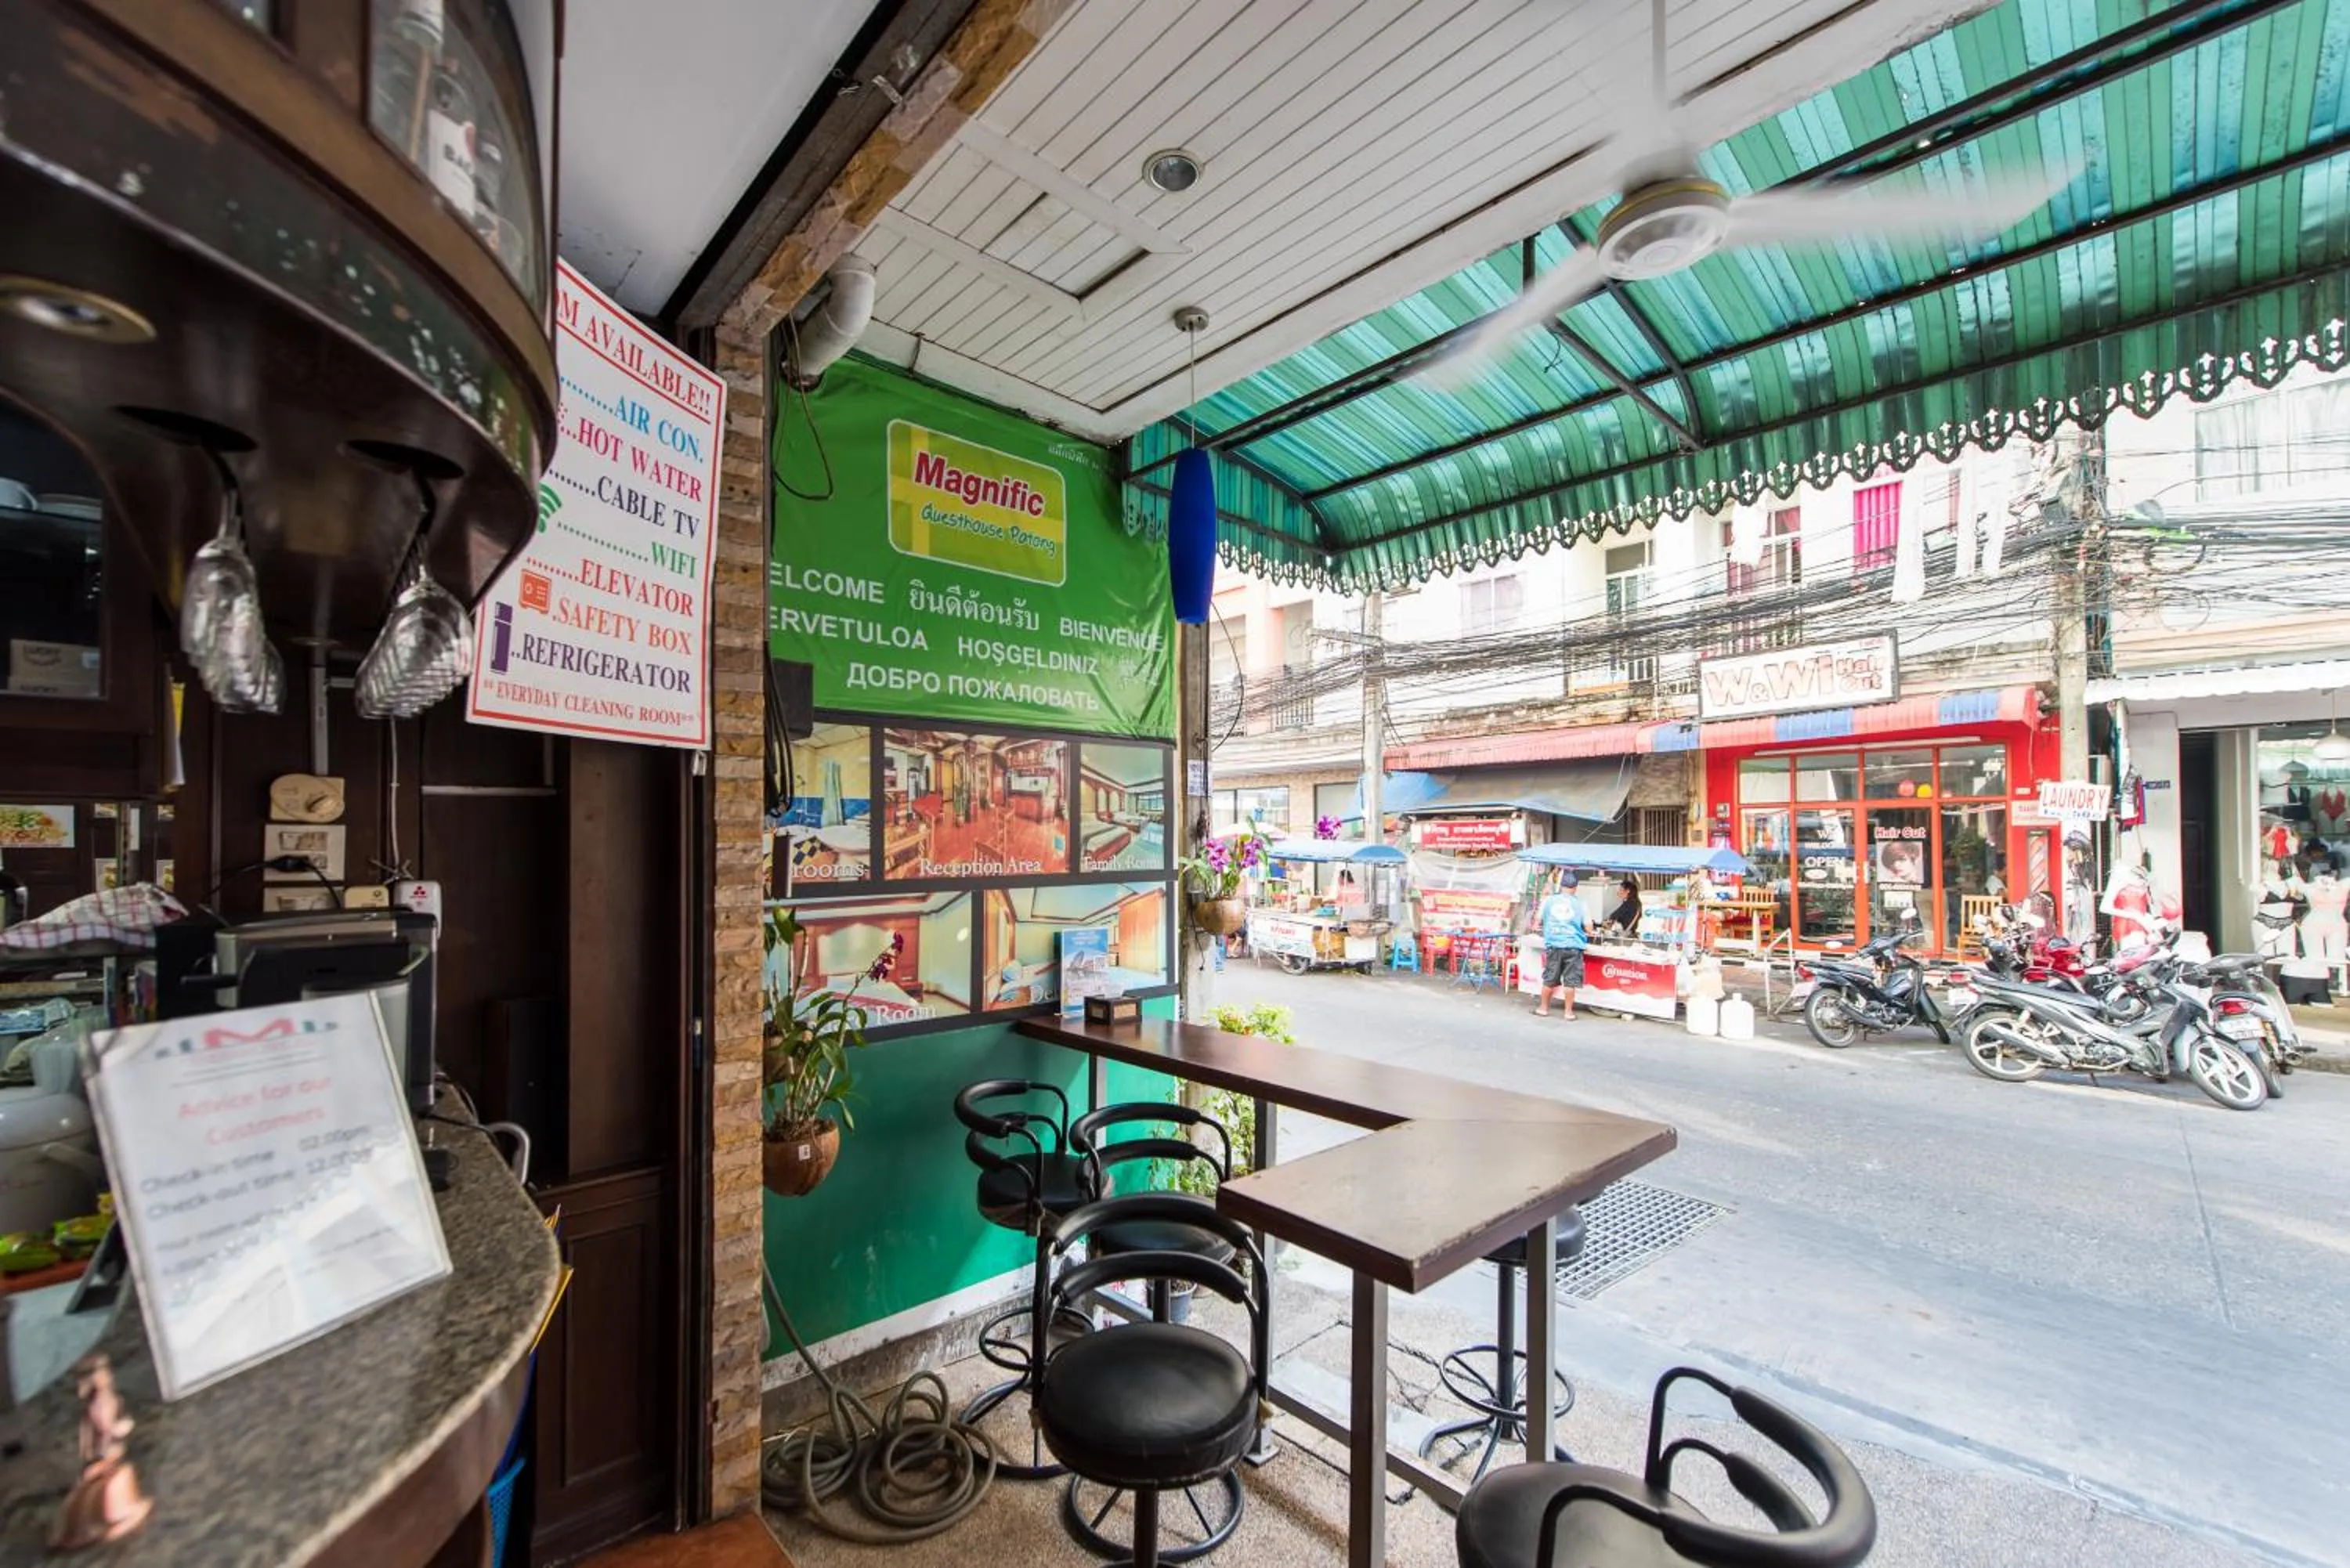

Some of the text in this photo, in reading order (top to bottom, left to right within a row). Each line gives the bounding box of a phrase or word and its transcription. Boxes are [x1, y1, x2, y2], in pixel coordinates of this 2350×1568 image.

[584, 315, 711, 415] AVAILABLE!!
[614, 394, 703, 464] AIR CON.
[577, 417, 703, 503] HOT WATER
[914, 450, 1046, 517] Magnific
[597, 475, 700, 540] CABLE TV
[921, 502, 1056, 557] Guesthouse Patong
[651, 540, 697, 580] WIFI
[770, 562, 885, 605] ELCOME
[580, 558, 693, 617] ELEVATOR
[559, 596, 692, 656] SAFETY BOX
[770, 605, 929, 652] ERVETULOA
[1059, 616, 1164, 653] BIENVENUE
[522, 633, 692, 694] REFRIGERATOR
[846, 662, 1100, 710] ДОБРО ПОЖАЛОВАТЬ
[496, 679, 562, 706] EVERYDAY
[565, 695, 634, 720] CLEANING
[2041, 786, 2107, 811] LAUNDRY
[1874, 826, 1926, 838] Hair Cut
[792, 862, 865, 878] rooms
[919, 858, 1042, 878] Reception Area
[1804, 855, 1842, 867] OPEN
[876, 1004, 938, 1026] Room
